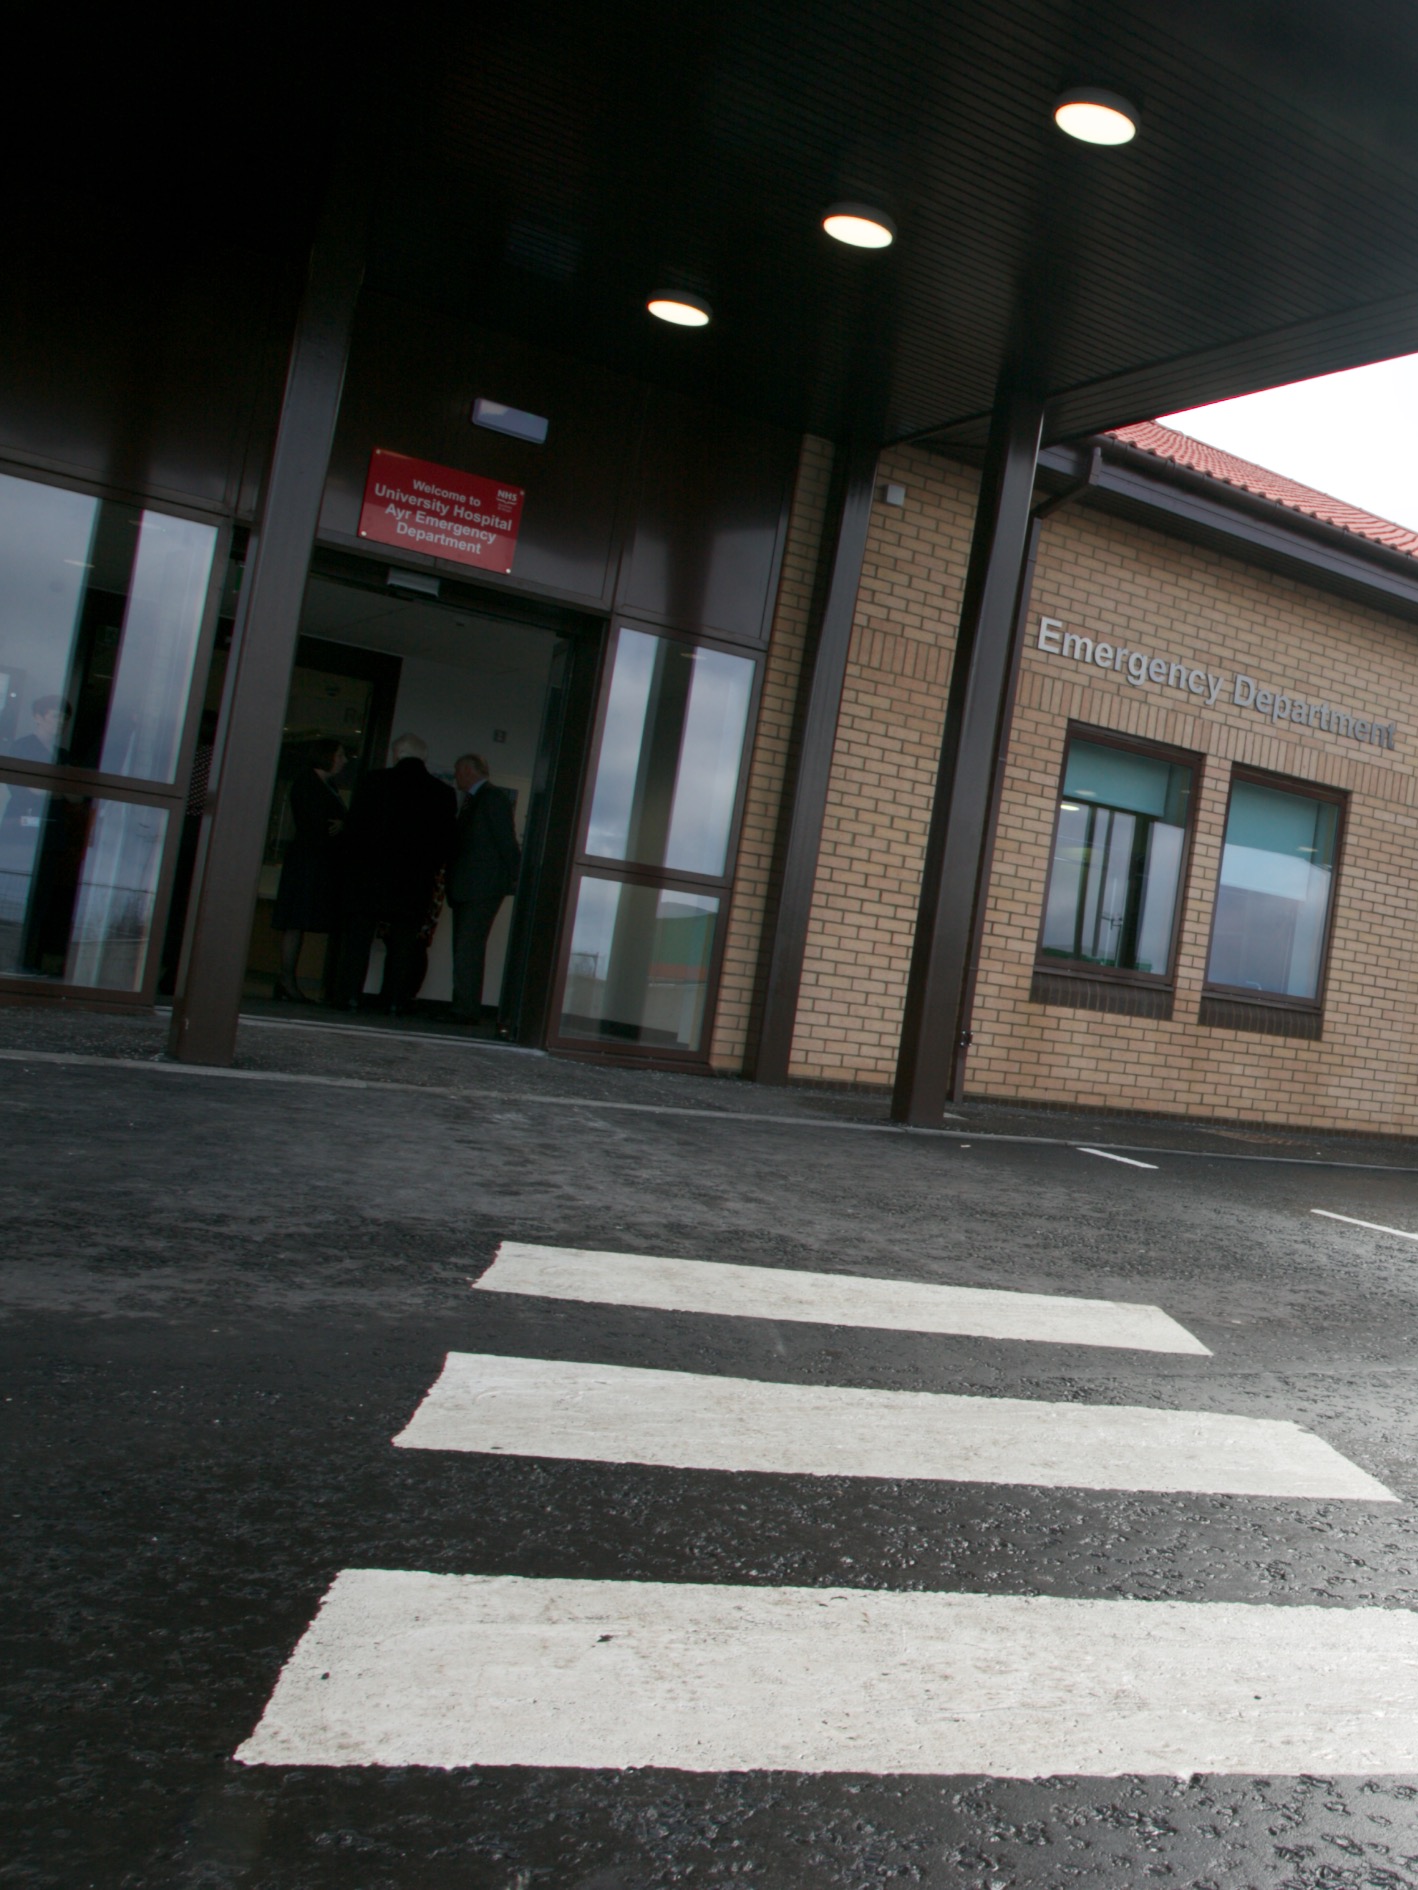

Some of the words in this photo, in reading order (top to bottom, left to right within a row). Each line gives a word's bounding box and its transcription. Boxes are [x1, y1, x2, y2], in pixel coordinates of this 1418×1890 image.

[374, 482, 450, 517] University
[453, 504, 513, 532] Hospital
[412, 479, 467, 503] Welcome
[469, 495, 481, 507] to
[497, 489, 518, 501] NHS
[385, 503, 412, 521] Ayr
[415, 511, 497, 545] Emergency
[396, 521, 482, 555] Department
[1037, 616, 1224, 705] Emergency
[1233, 673, 1396, 750] Department
